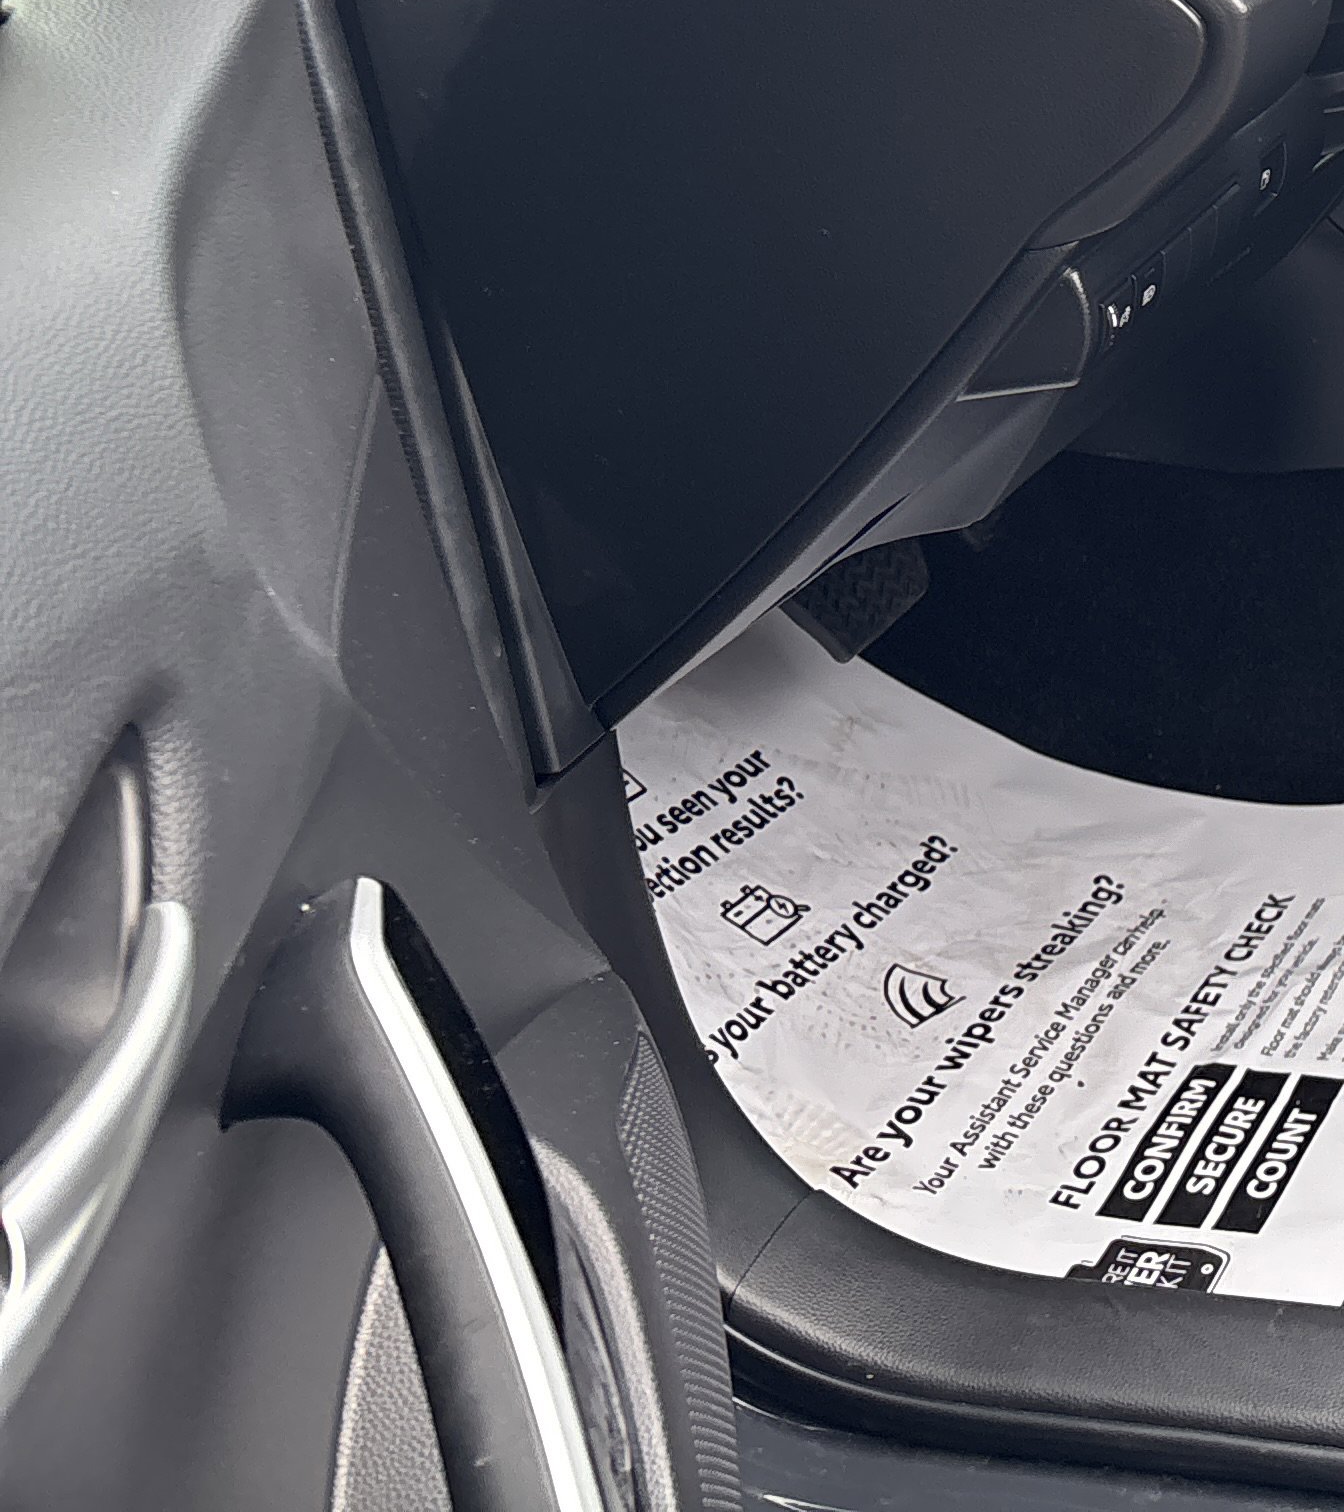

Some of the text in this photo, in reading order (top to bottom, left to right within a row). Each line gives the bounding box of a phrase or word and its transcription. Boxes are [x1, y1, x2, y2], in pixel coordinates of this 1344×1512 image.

[656, 790, 719, 834] seen
[708, 749, 771, 804] your
[710, 776, 804, 854] results?
[709, 996, 775, 1060] your
[755, 923, 864, 1000] battery
[852, 835, 958, 929] charged?
[829, 874, 1125, 1190] Are your wipers streaking?
[1048, 893, 1297, 1210] FLOOR MAT SAFETY CHECK
[1260, 1031, 1287, 1057] Floor
[1281, 1007, 1301, 1029] mat
[1294, 971, 1321, 1007] should
[1294, 1005, 1327, 1041] factory
[912, 1158, 959, 1195] Your
[950, 1079, 1022, 1156] Assistant
[1010, 1021, 1066, 1078] Service
[1054, 954, 1118, 1020] Manager
[978, 1129, 1020, 1171] with
[1006, 1083, 1055, 1132] these
[1048, 1002, 1114, 1084] questions
[1106, 973, 1137, 1000] and
[1122, 1078, 1217, 1200] CONFIRM
[1185, 1095, 1266, 1196] SECURE
[1246, 1107, 1318, 1200] COUNT
[1124, 1251, 1171, 1286] ER
